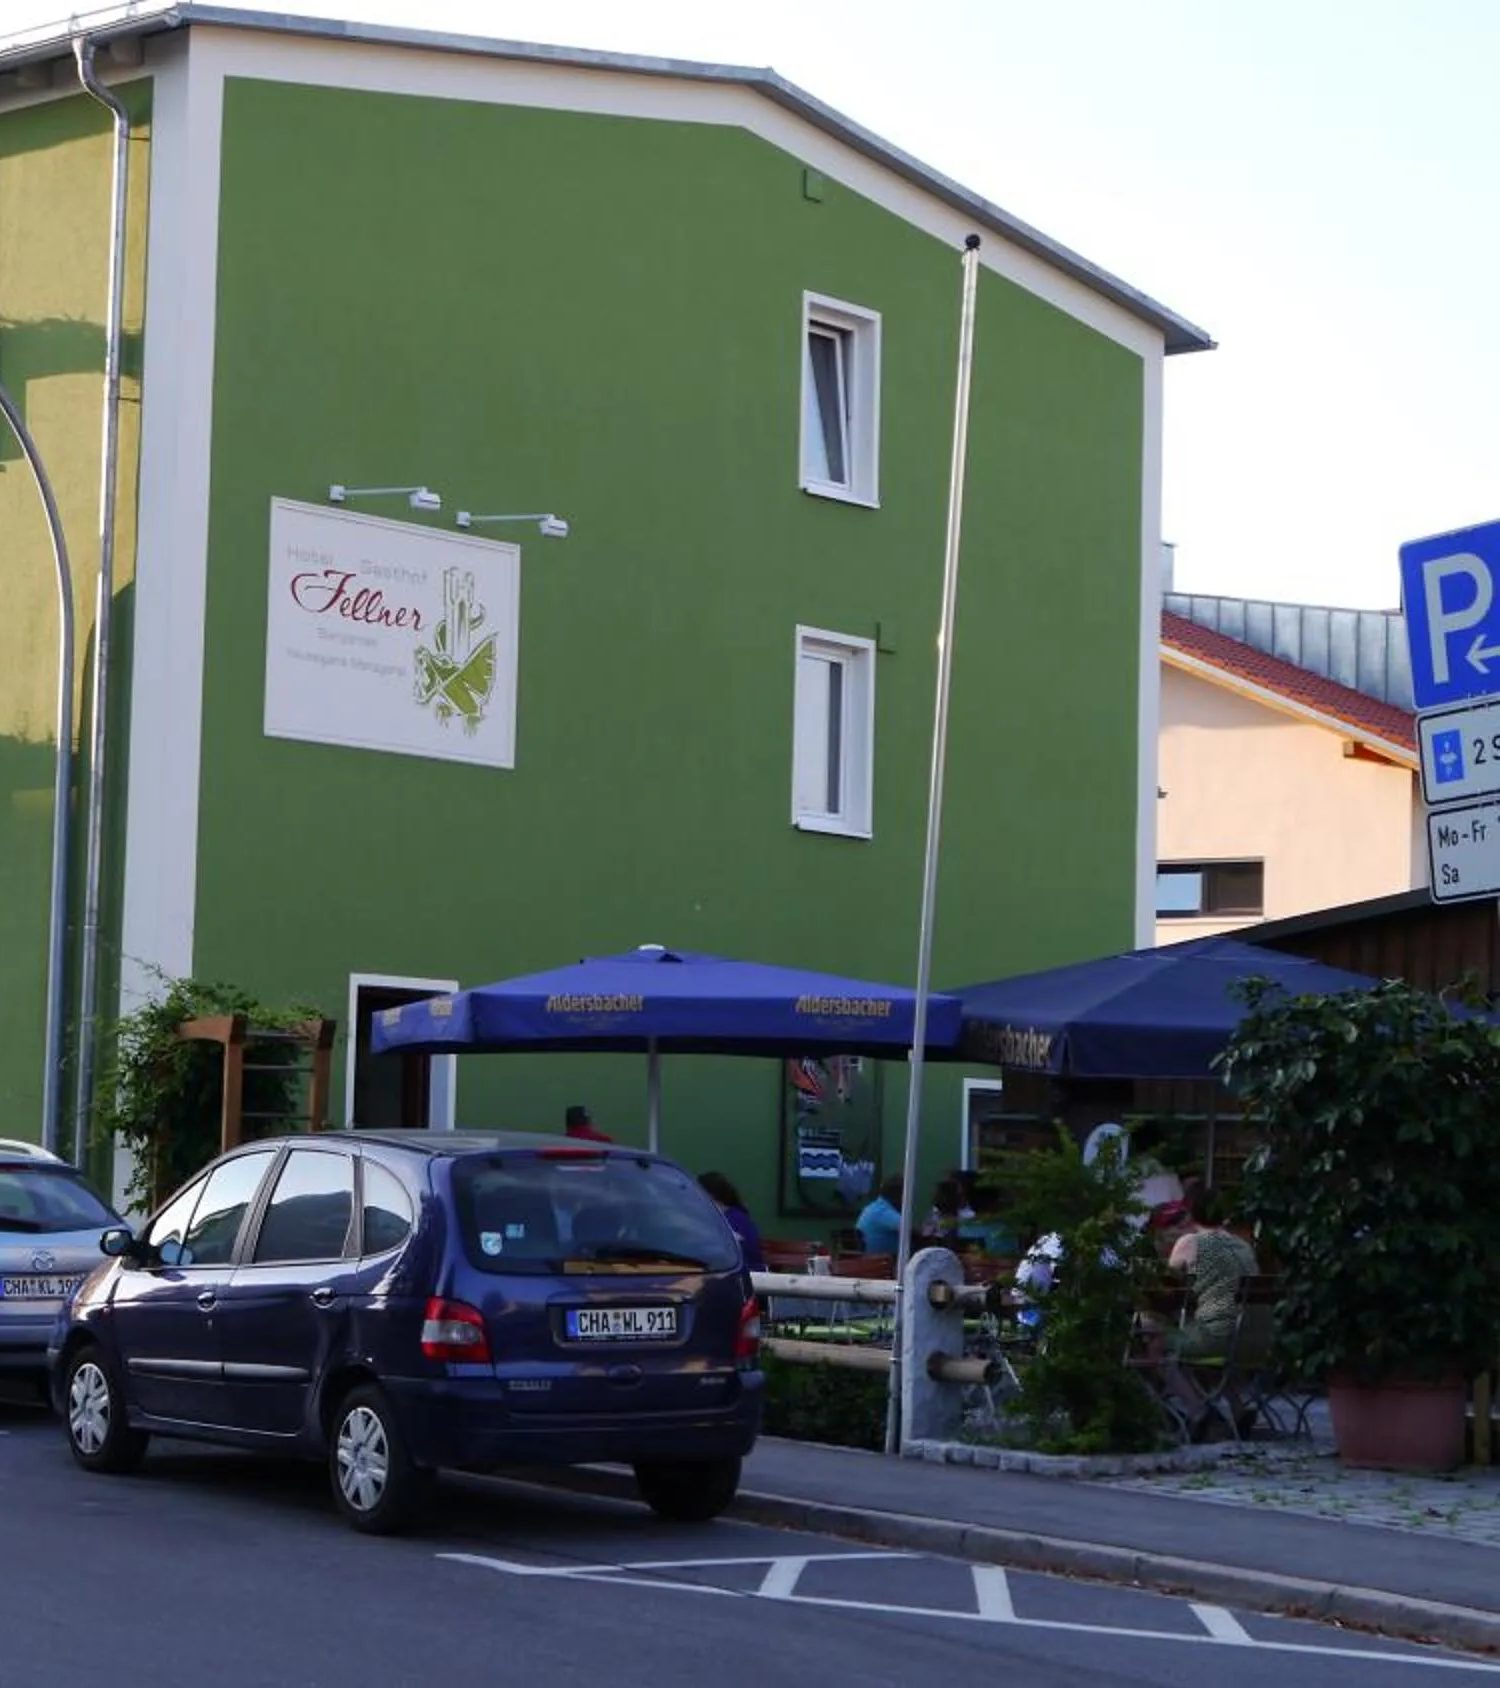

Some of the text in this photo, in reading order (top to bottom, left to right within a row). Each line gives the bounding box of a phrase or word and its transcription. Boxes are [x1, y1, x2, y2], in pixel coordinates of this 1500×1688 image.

[291, 569, 428, 632] Fellner
[1422, 552, 1494, 686] P
[1441, 863, 1460, 885] Sa
[3, 1279, 29, 1295] CHA
[579, 1310, 674, 1333] CHA WL 911
